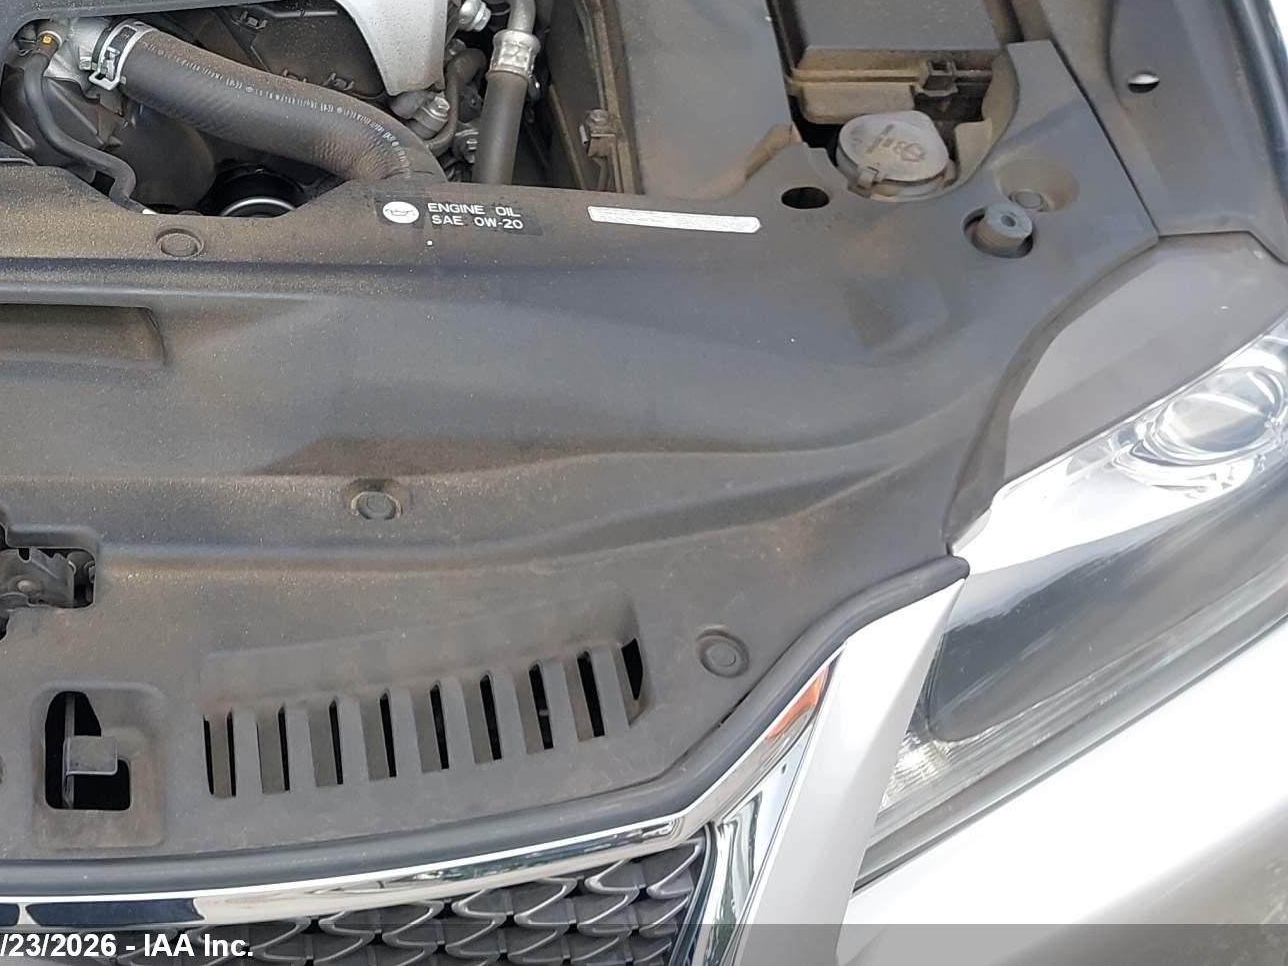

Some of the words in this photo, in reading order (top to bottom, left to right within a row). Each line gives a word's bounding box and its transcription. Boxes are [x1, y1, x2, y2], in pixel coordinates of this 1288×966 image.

[427, 202, 486, 216] ENGINE
[495, 206, 522, 218] OIL
[431, 215, 465, 226] SAE
[473, 216, 524, 230] 0W-20
